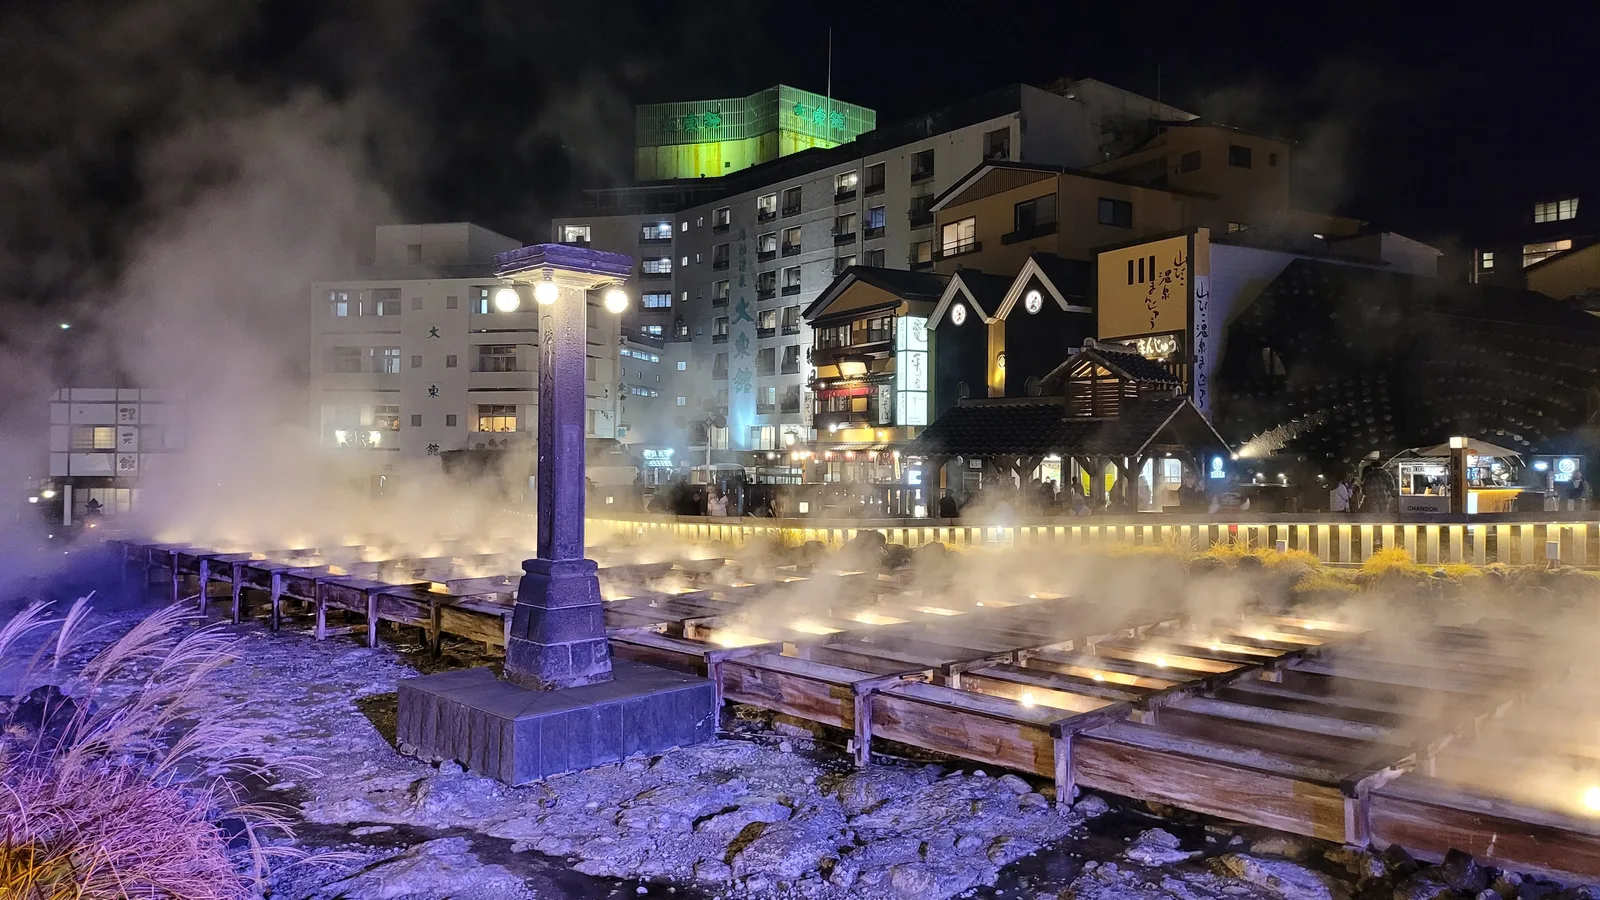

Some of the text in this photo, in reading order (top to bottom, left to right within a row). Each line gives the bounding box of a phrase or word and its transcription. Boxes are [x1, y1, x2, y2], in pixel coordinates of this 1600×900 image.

[1158, 269, 1173, 301] 温泉
[1137, 334, 1177, 356] まんじゅう
[1407, 505, 1438, 513] CHANDON
